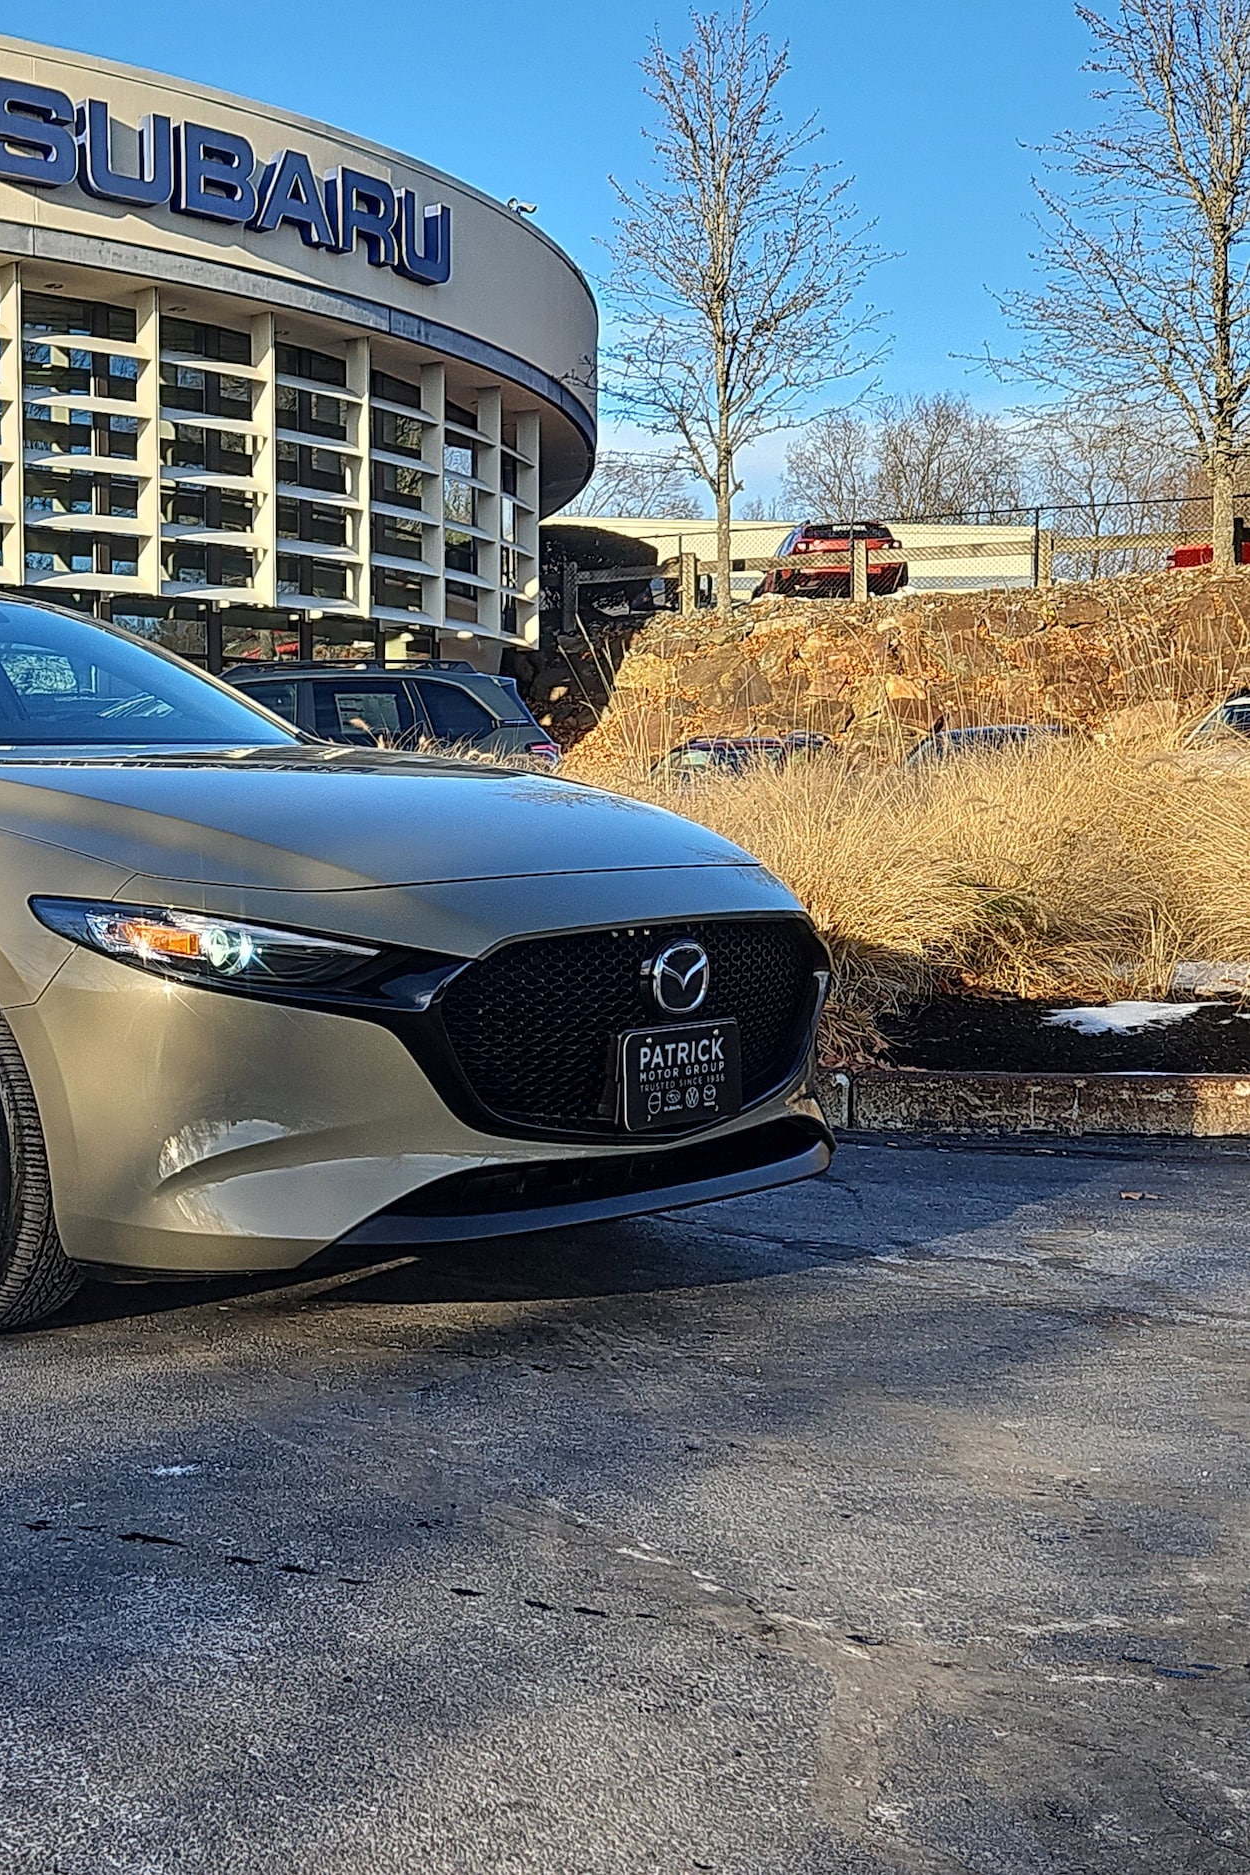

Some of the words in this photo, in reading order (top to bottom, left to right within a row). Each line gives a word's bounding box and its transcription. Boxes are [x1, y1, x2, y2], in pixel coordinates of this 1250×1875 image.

[639, 1037, 725, 1071] PATRICK
[639, 1067, 679, 1083] MOTOR
[685, 1061, 725, 1075] GROUP
[640, 1080, 676, 1093] TRUSTED
[679, 1076, 703, 1088] SINCE
